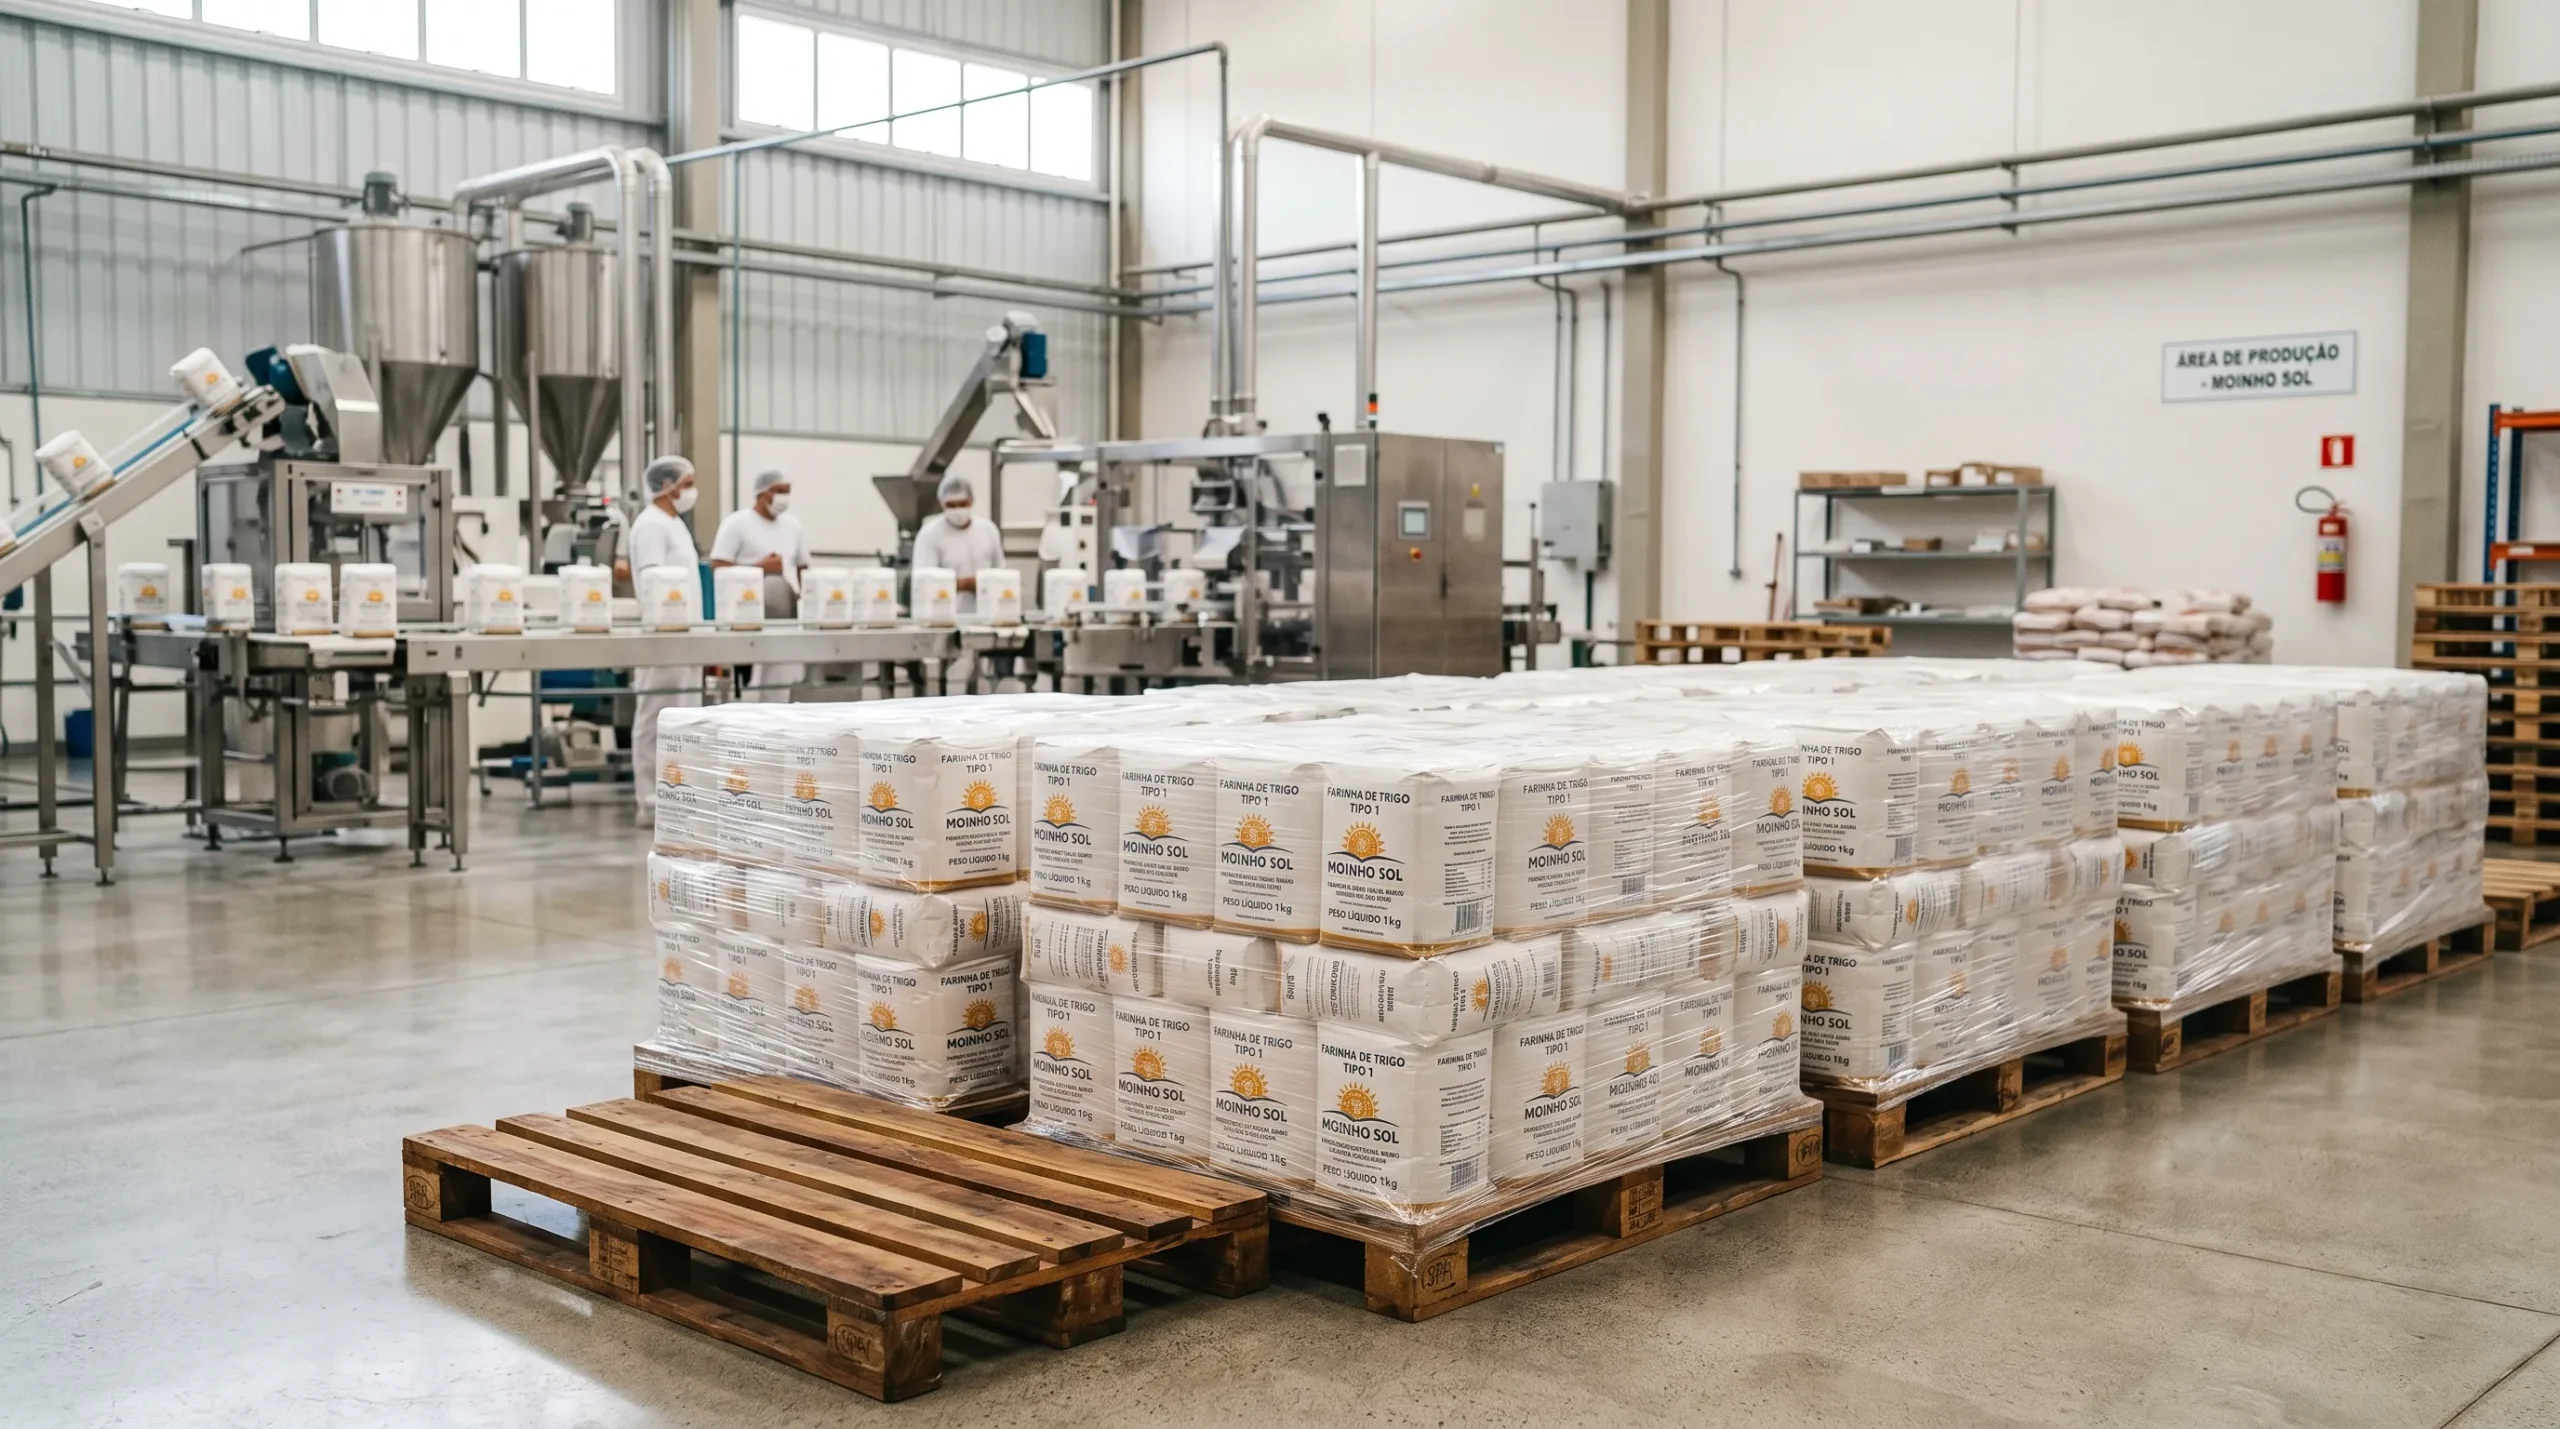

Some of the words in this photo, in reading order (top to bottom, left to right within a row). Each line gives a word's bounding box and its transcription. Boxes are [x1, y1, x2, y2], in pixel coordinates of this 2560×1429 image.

[2224, 350, 2242, 366] DE
[2212, 373, 2276, 389] MOINHO
[2282, 371, 2312, 386] SOL
[1834, 747, 1861, 756] TRIGO
[2337, 745, 2349, 753] OL
[1808, 756, 1827, 764] TIPO
[1072, 766, 1097, 776] TRIGO
[2140, 771, 2159, 780] SOL
[1048, 776, 1064, 785] TIPO
[1154, 775, 1165, 784] DE
[1167, 776, 1194, 786] TRIGO
[1220, 779, 1254, 792] FARINHA
[1256, 783, 1268, 793] DE
[1270, 784, 1299, 795] TRIGO
[1141, 786, 1160, 796] TIPO
[1327, 787, 1363, 800] FARINHA
[1365, 791, 1377, 801] DE
[1379, 792, 1410, 804] TRIGO
[1241, 795, 1261, 806] TIPO
[1264, 796, 1269, 807] 1
[1350, 803, 1371, 814] TIPO
[1375, 805, 1379, 816] 1
[1803, 805, 1830, 817] INHO
[1834, 808, 1856, 818] SOL
[946, 816, 991, 829] MOINHO
[993, 814, 1010, 824] SOL
[1072, 833, 1091, 845] SOL
[1167, 846, 1188, 858] SOL
[1221, 851, 1266, 868] MOINHO
[1271, 857, 1293, 870] SOL
[1528, 852, 1570, 869] MOINHO
[1328, 861, 1374, 878] MOINHO
[1379, 868, 1403, 881] SOL
[1223, 897, 1240, 907] PESO
[1328, 908, 1346, 918] PESO
[2128, 949, 2148, 959] SOL
[1814, 956, 1825, 964] DE
[1828, 957, 1857, 968] TRIGO
[1825, 967, 1829, 976] 1
[967, 984, 986, 994] TIPO
[1070, 1001, 1095, 1012] TRIGO
[1149, 1017, 1160, 1027] DE
[1162, 1020, 1190, 1031] TRIGO
[1801, 1015, 1825, 1026] NHO
[1828, 1018, 1851, 1029] SOL
[947, 1031, 991, 1049] MOINHO
[1135, 1028, 1154, 1039] TIPO
[1250, 1034, 1260, 1044] DE
[895, 1034, 914, 1050] SOL
[1235, 1045, 1255, 1057] TIPO
[1258, 1048, 1263, 1059] 1
[1322, 1044, 1357, 1061] FARINHA
[1360, 1052, 1371, 1063] DE
[1374, 1054, 1405, 1067] TRIGO
[1071, 1067, 1092, 1080] SOL
[1344, 1063, 1366, 1075] TIPO
[1368, 1067, 1373, 1077] 1
[1118, 1079, 1160, 1098] MOINHO
[1163, 1088, 1185, 1102] SOL
[1216, 1098, 1260, 1118] MOINHO
[1263, 1108, 1287, 1123] SOL
[1525, 1099, 1567, 1120] MOINHO
[1373, 1128, 1399, 1144] SOL
